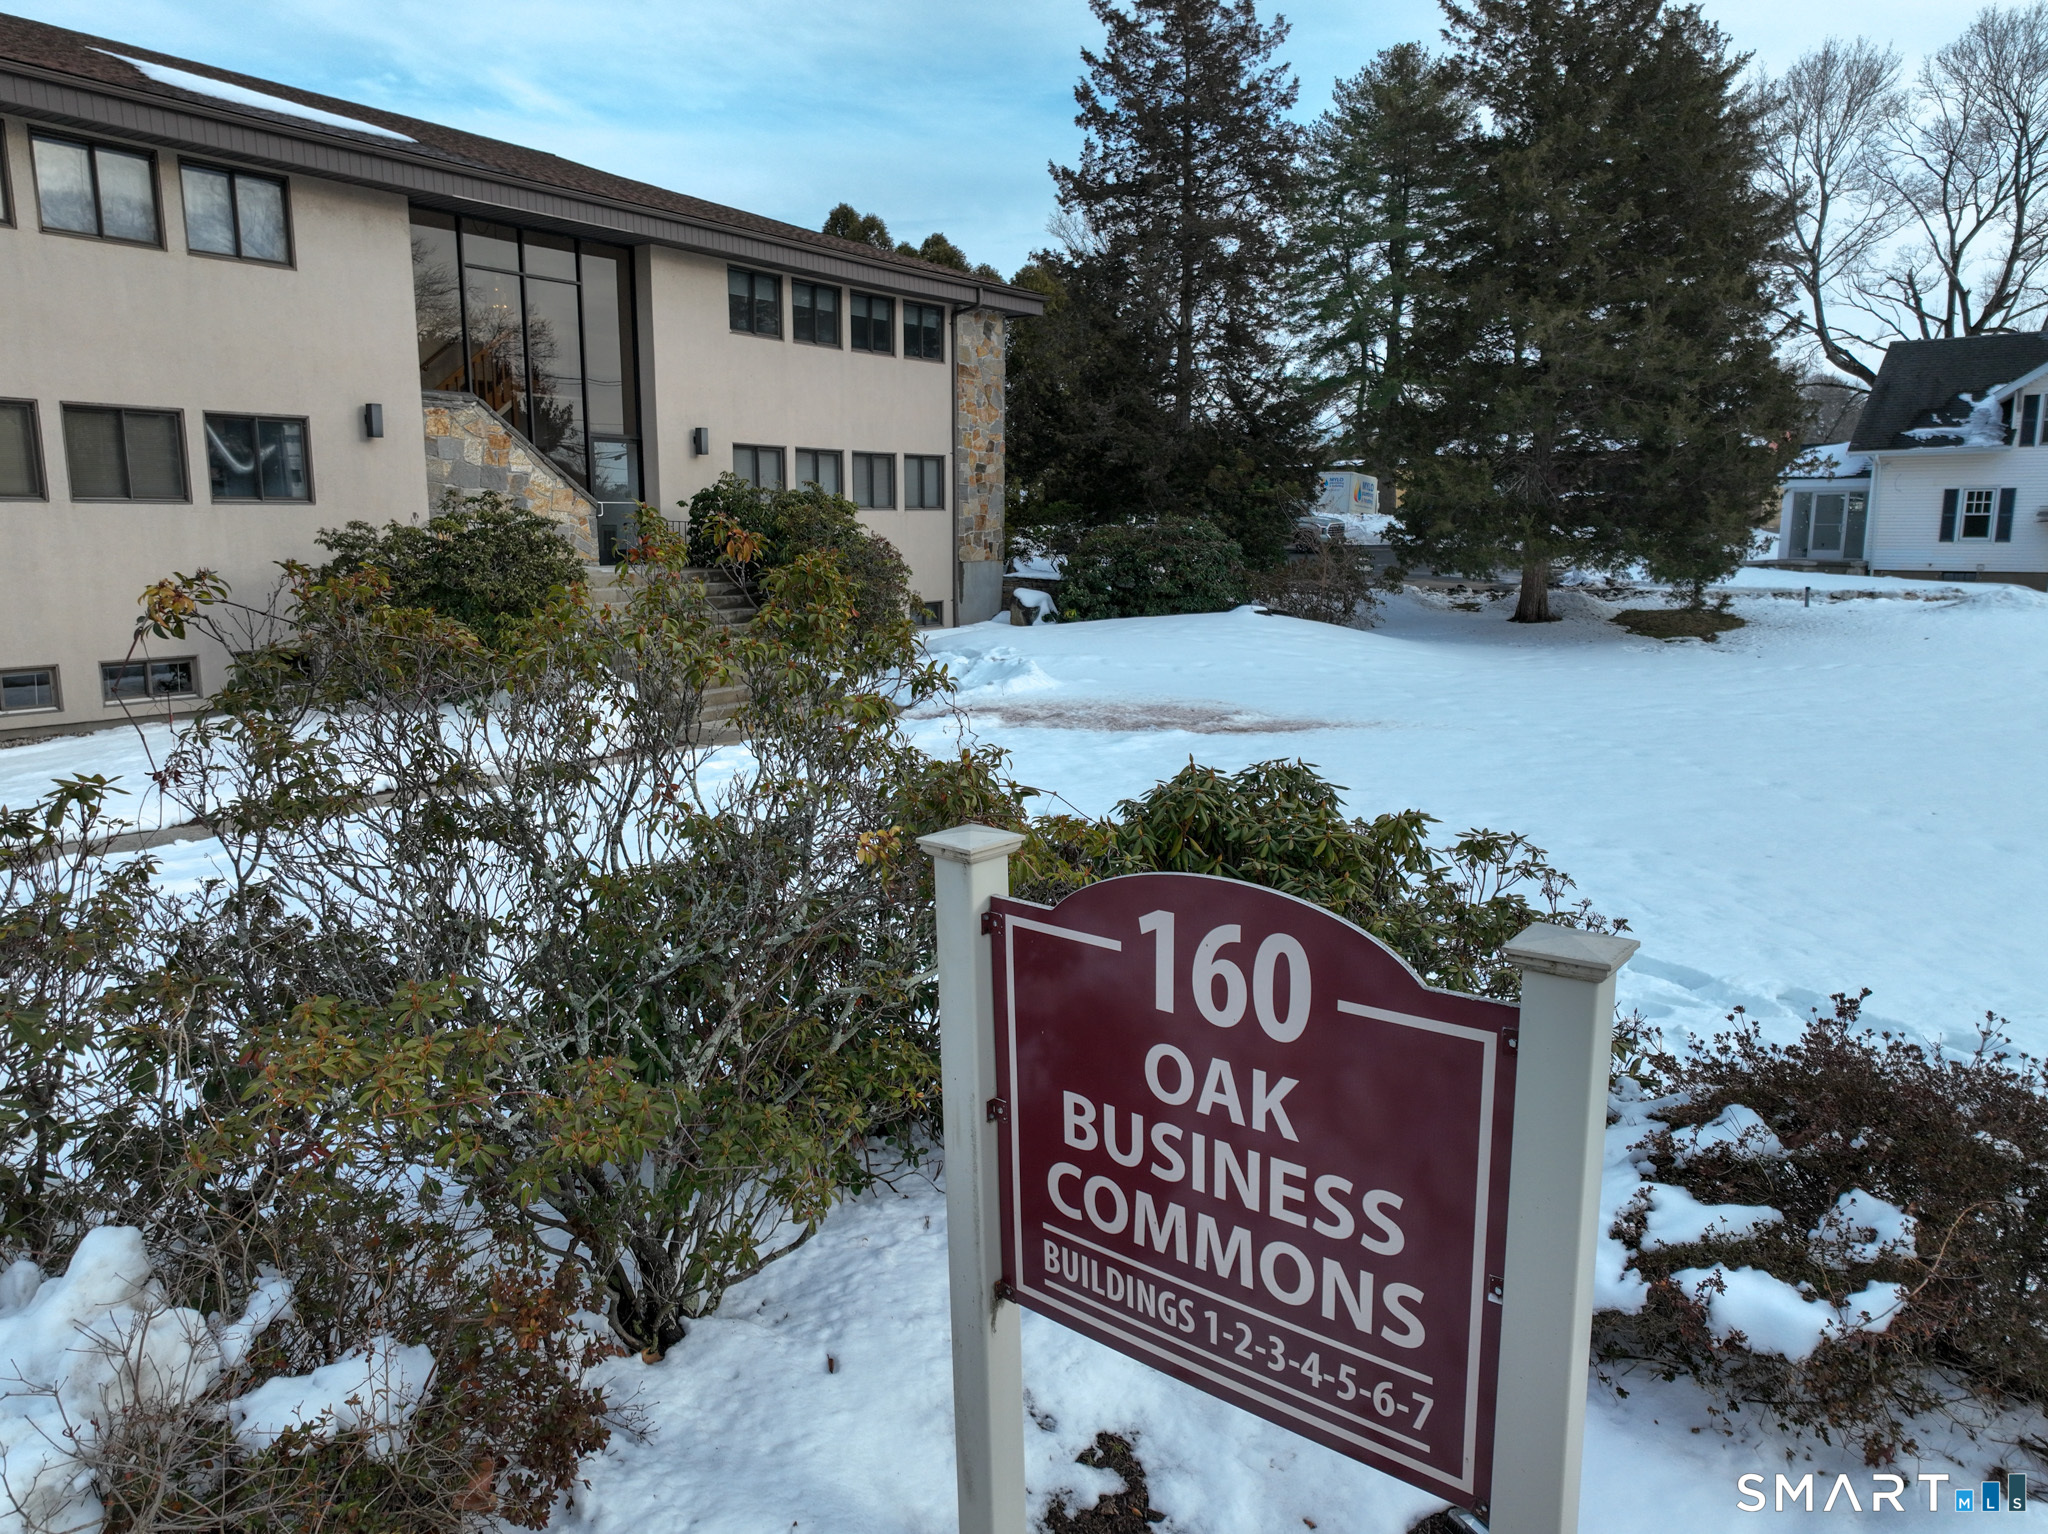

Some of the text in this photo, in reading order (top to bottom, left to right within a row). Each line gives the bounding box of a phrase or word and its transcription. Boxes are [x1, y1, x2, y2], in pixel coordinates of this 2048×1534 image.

[1138, 909, 1312, 1043] 160
[1062, 1090, 1405, 1256] BUSINESS
[1144, 1043, 1300, 1143] OAK
[1043, 1238, 1435, 1431] BUILDINGS 1-2-3-4-5-6-7
[1047, 1161, 1426, 1349] COMMONS
